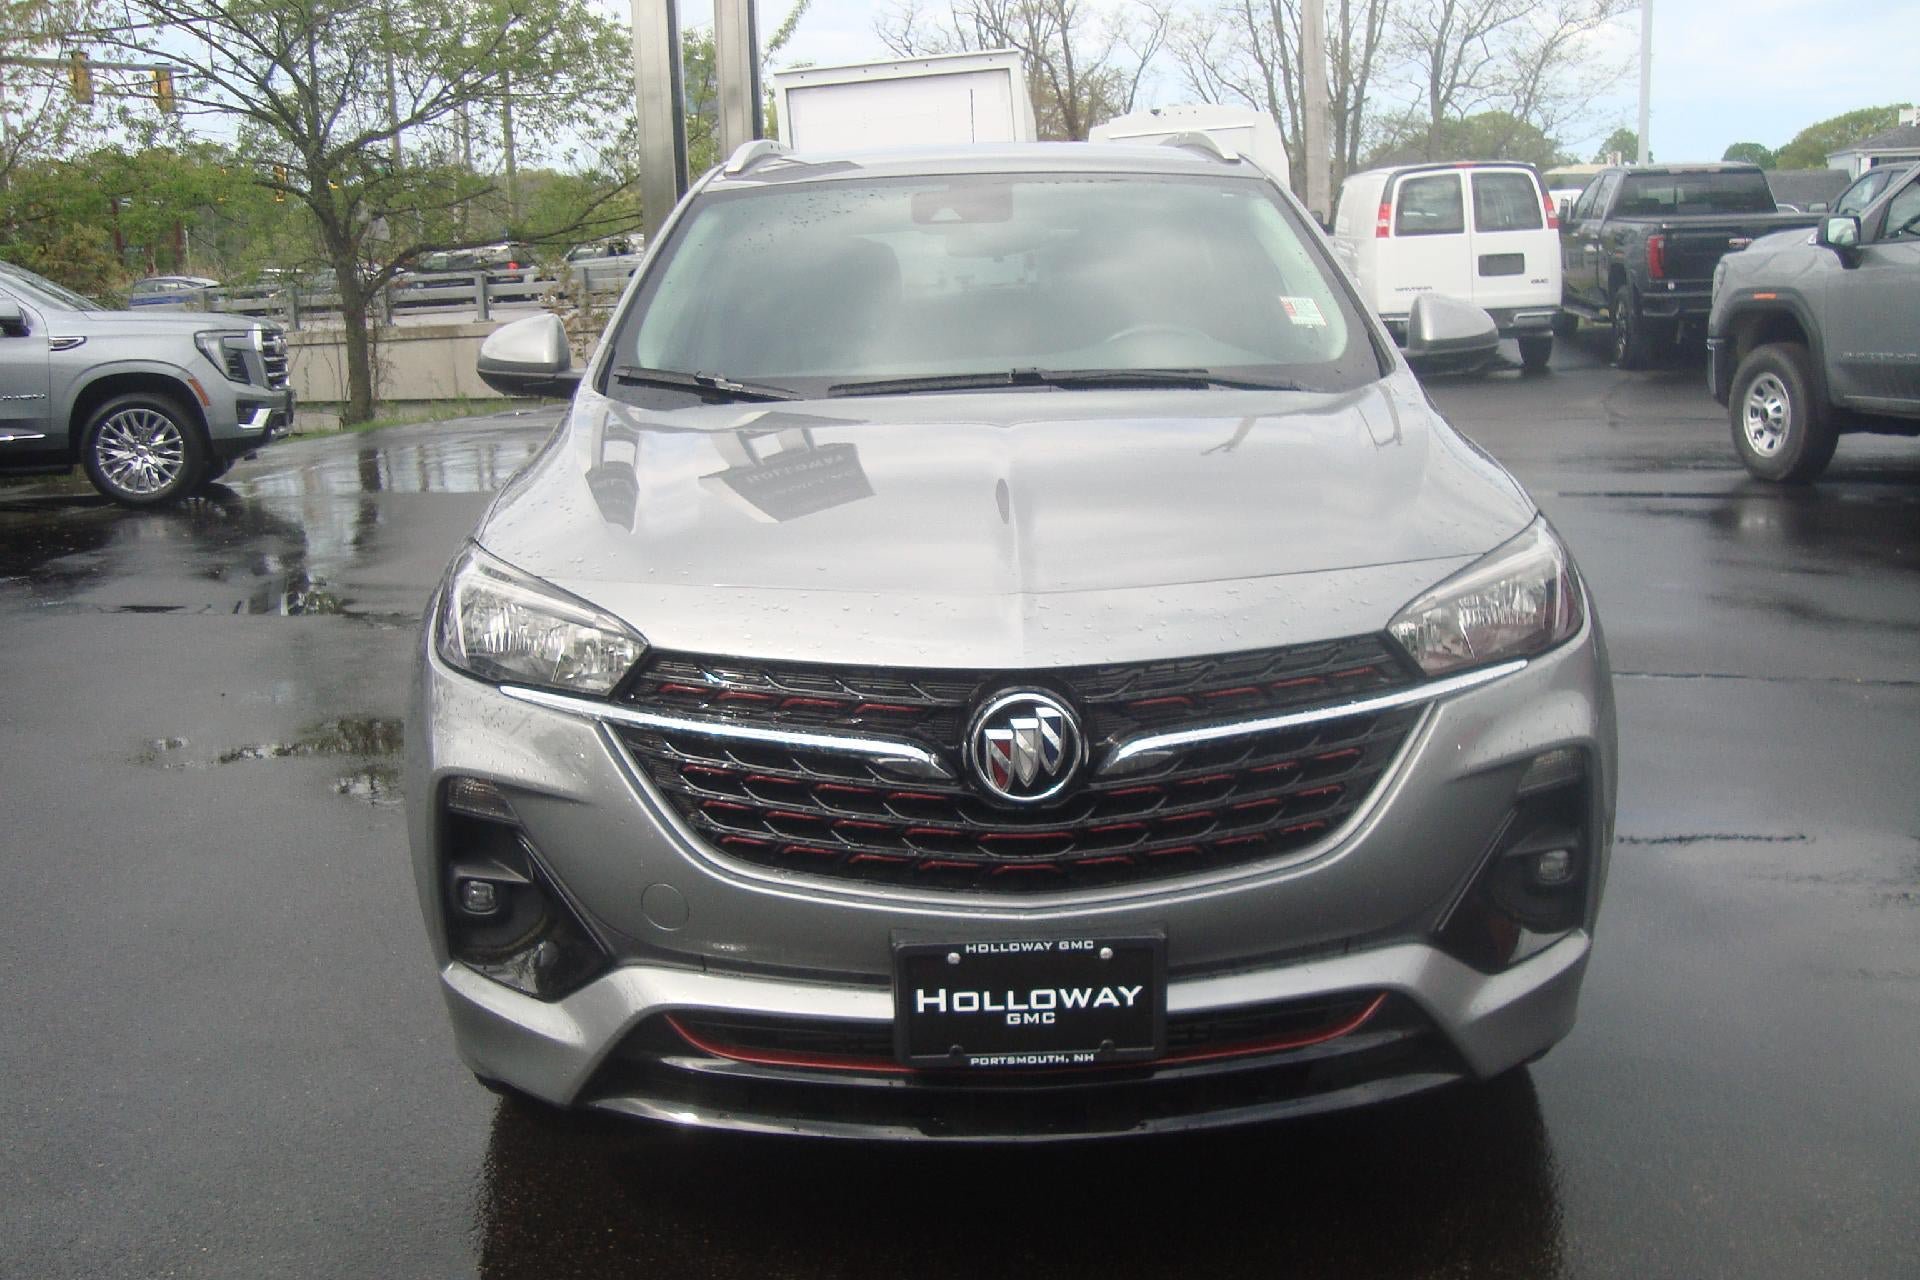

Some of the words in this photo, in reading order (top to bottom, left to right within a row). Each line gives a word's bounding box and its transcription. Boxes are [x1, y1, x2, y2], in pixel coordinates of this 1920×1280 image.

[965, 942, 1053, 954] HOLLOWAY
[1059, 940, 1094, 950] GMC
[916, 985, 1143, 1014] HOLLOWAY
[1006, 1012, 1056, 1025] GMC
[970, 1055, 1070, 1066] PORTSMOUTH,
[1074, 1053, 1094, 1063] NH
